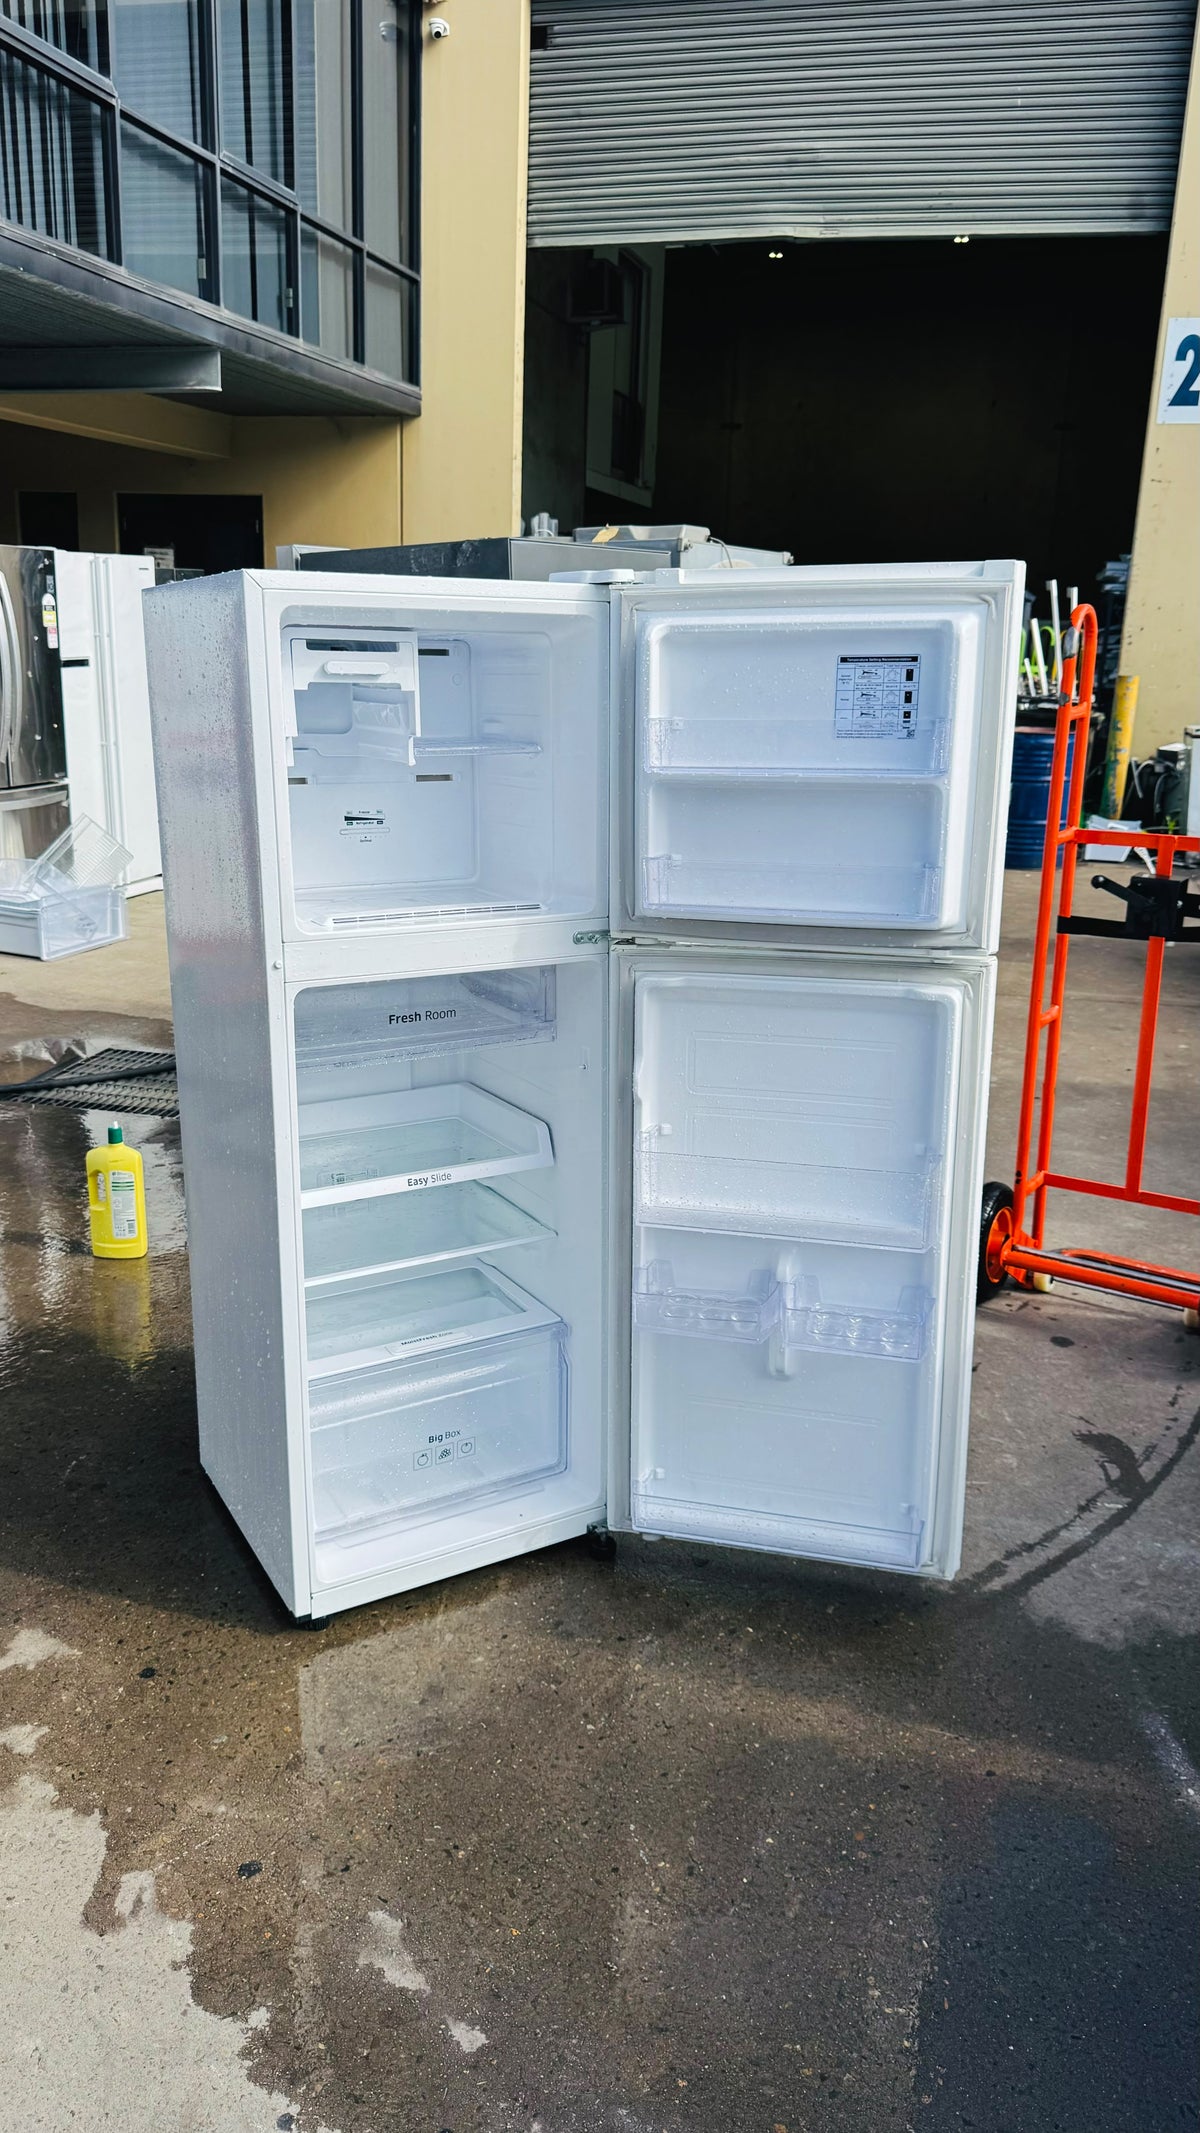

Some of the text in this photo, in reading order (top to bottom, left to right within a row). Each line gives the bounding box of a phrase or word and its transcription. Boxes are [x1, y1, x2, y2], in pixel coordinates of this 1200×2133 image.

[389, 1009, 457, 1025] Fresh Room
[407, 1172, 452, 1187] Easy Slide
[428, 1429, 461, 1444] Big Box
